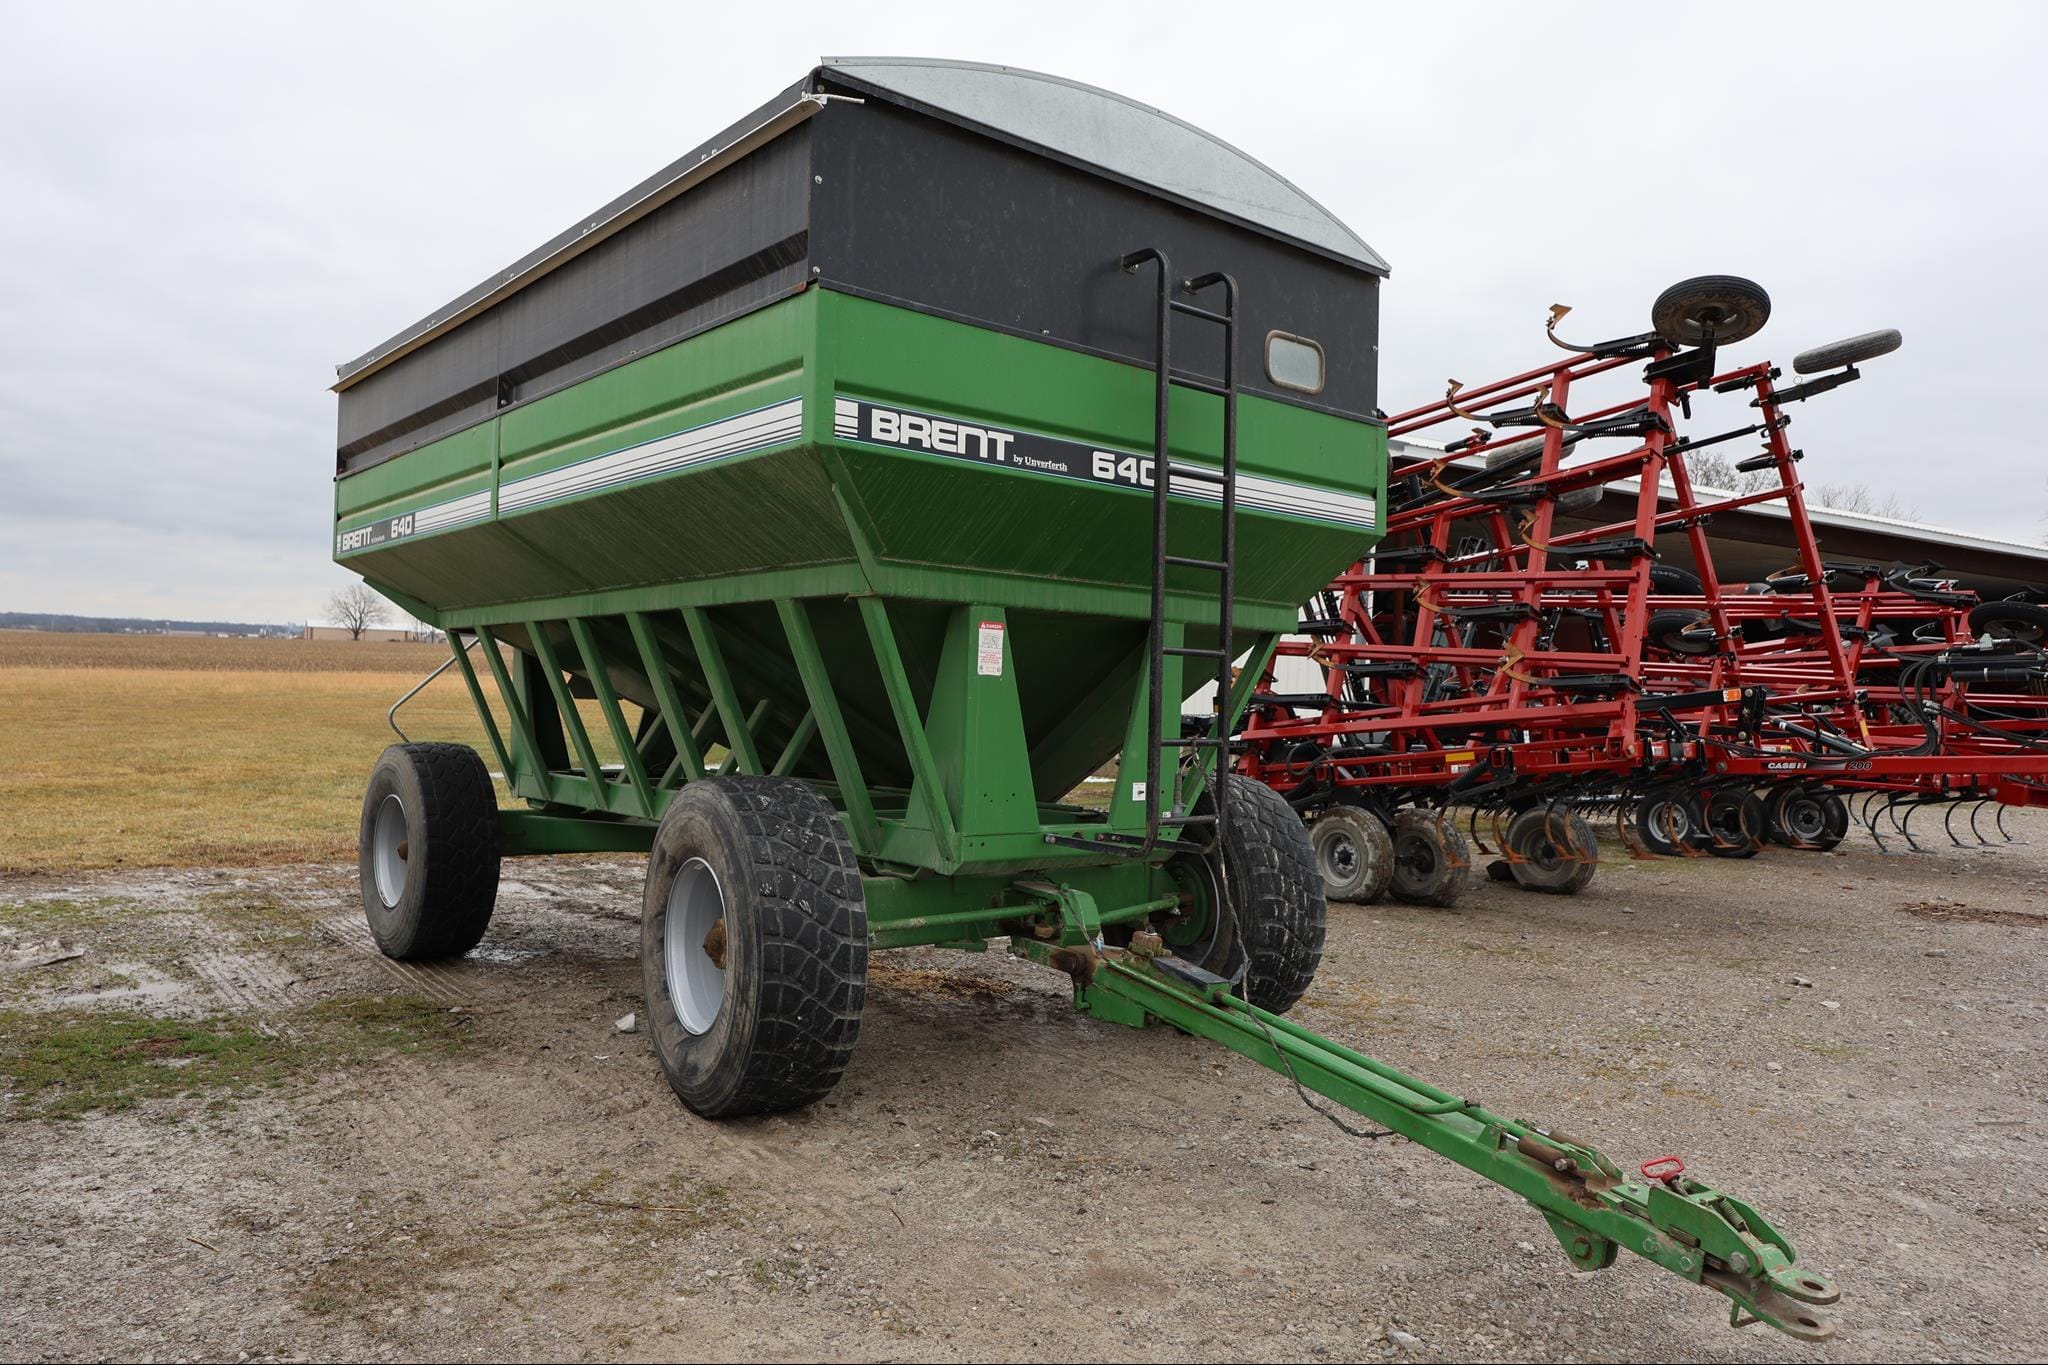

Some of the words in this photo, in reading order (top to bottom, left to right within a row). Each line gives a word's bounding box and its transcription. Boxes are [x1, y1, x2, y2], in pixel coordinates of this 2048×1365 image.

[871, 408, 1014, 461] BRENT
[1013, 454, 1024, 465] by
[1024, 456, 1068, 472] Unverferth
[342, 526, 373, 551] BRENT
[391, 515, 413, 539] 640
[1847, 761, 1873, 770] 200
